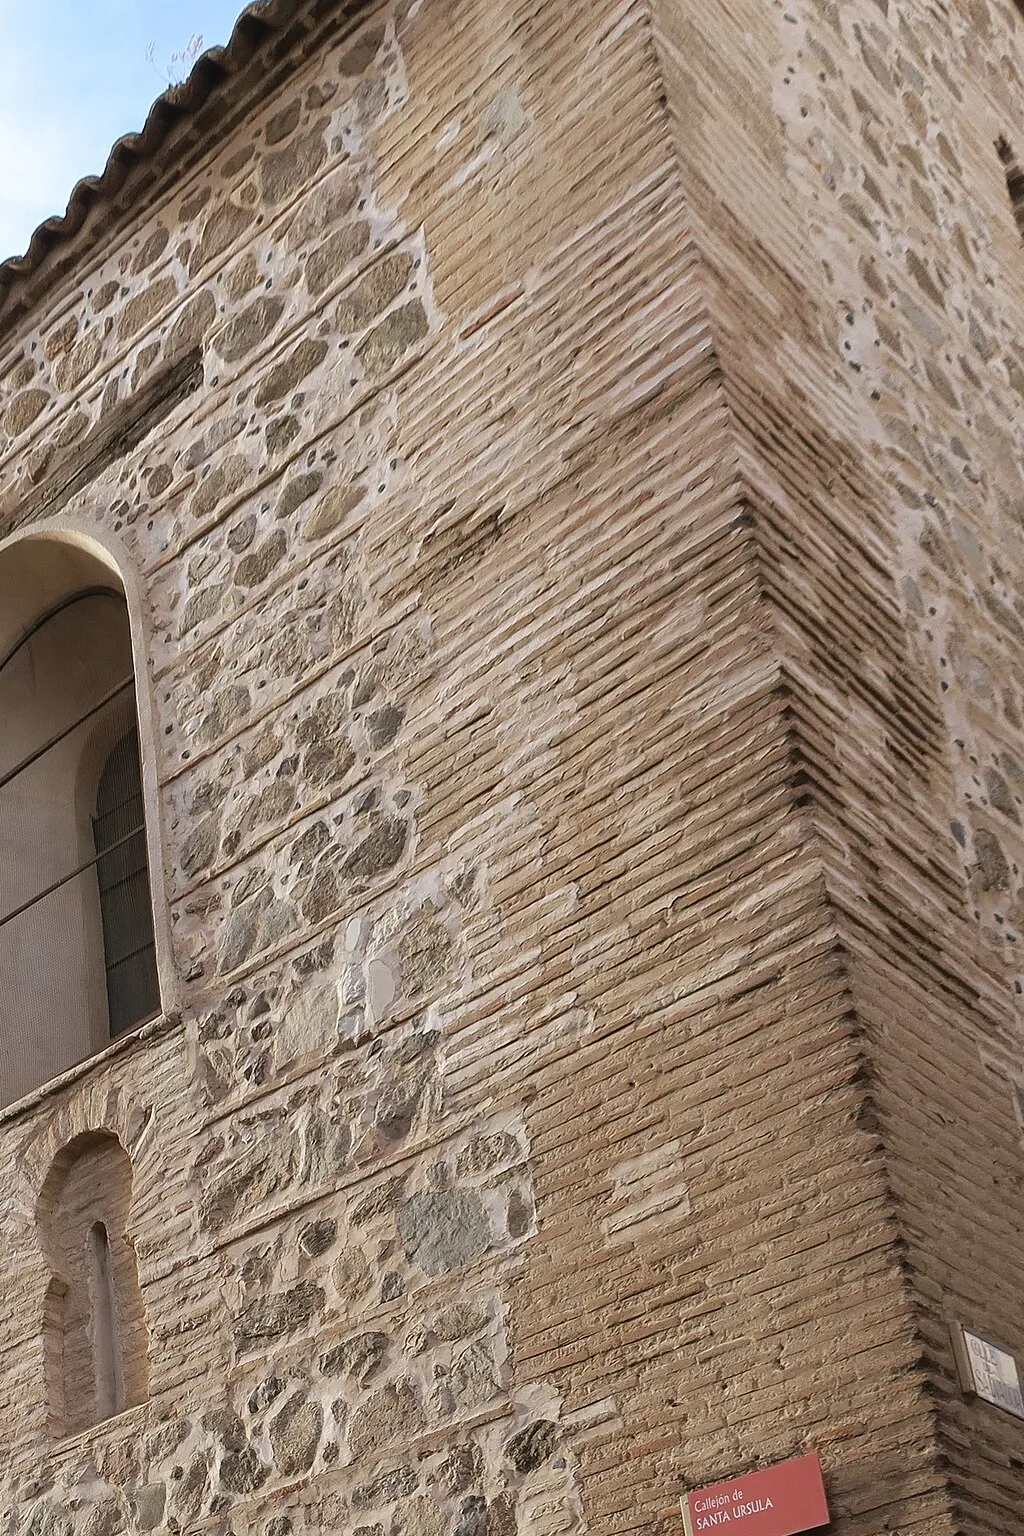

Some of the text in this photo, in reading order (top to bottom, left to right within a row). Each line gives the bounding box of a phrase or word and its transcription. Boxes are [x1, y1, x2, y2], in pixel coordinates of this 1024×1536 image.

[694, 1489, 744, 1513] Callejón de
[696, 1497, 774, 1530] SANTA URSULA
